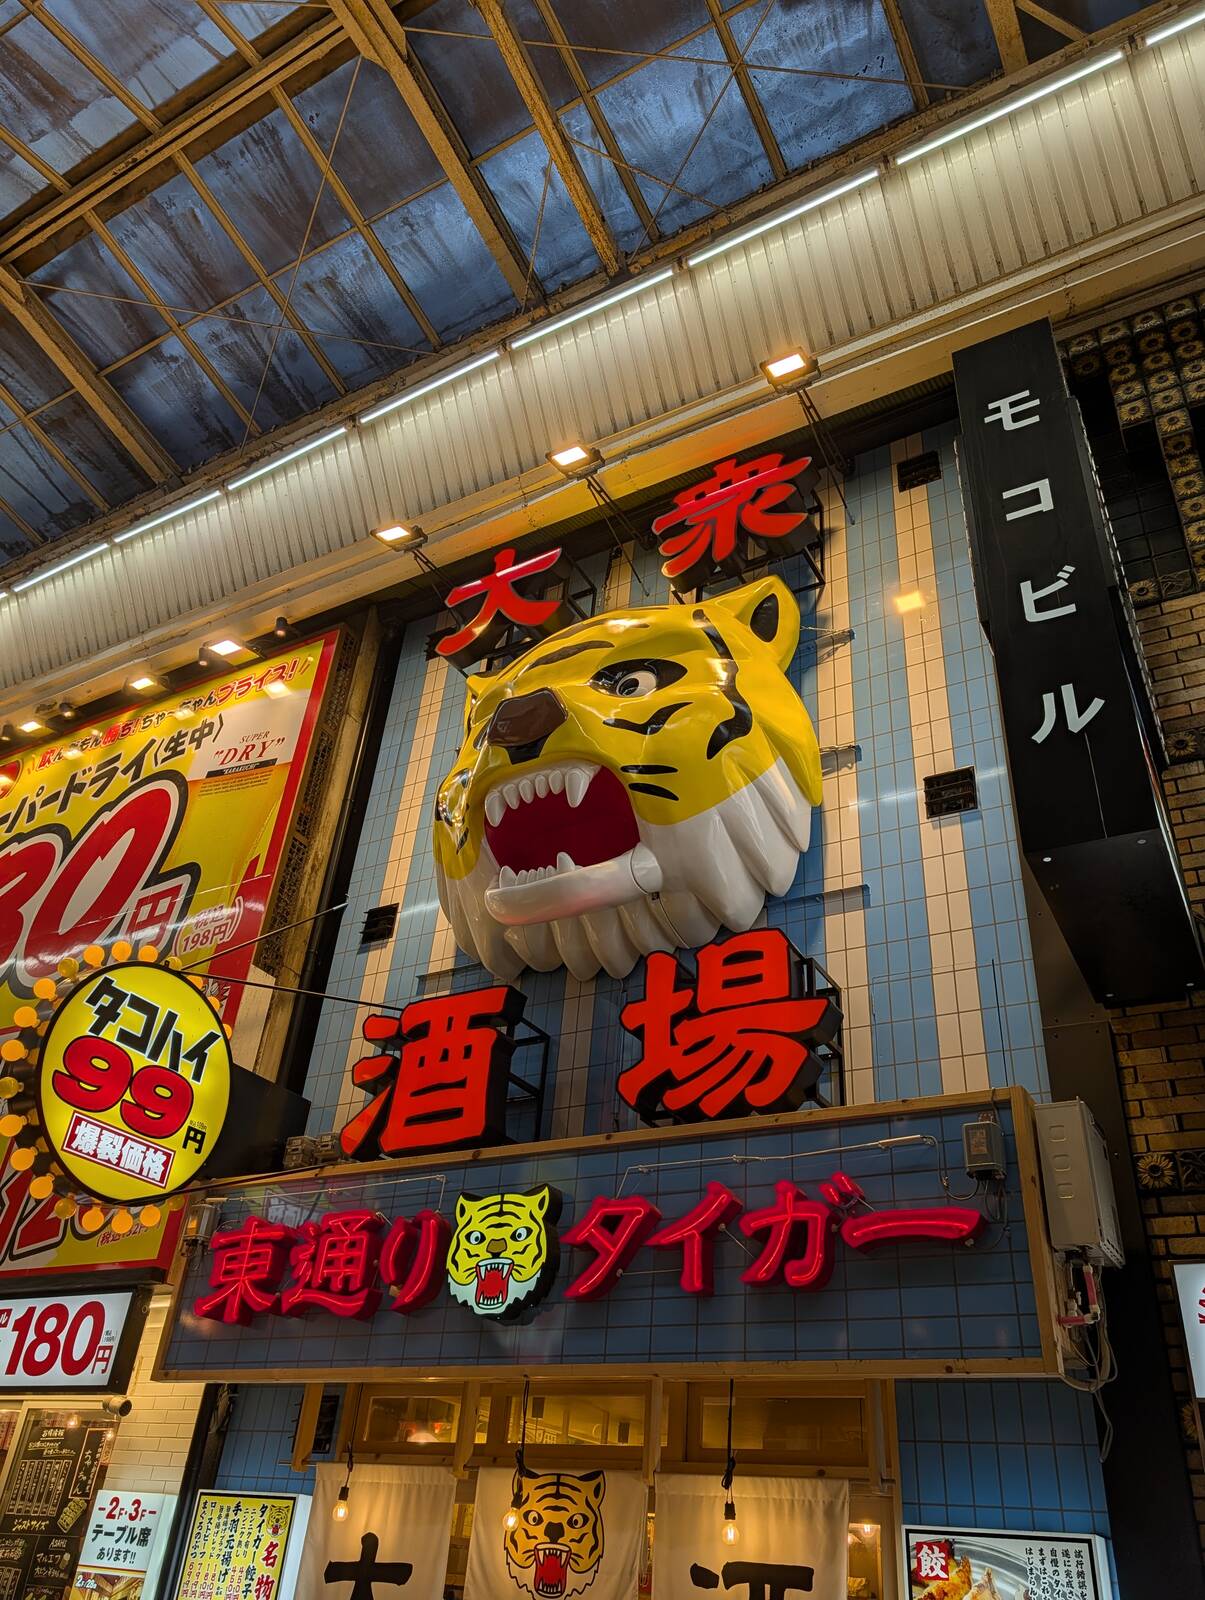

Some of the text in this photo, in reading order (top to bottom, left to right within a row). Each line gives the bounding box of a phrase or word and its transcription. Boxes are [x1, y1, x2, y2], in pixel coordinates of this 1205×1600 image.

[984, 390, 1105, 743] モコビル
[240, 731, 270, 744] SUPER
[86, 977, 220, 1083] タコハイ
[340, 928, 829, 1156] 酒場
[52, 1035, 194, 1139] 99
[71, 1121, 167, 1181] 爆裂価格
[182, 1126, 206, 1154] 円
[193, 1171, 987, 1327] 東通り タイガー
[91, 1523, 152, 1548] テーブル席
[242, 1503, 269, 1600] タイガー餃子
[255, 1541, 279, 1600] 名物
[917, 1544, 949, 1579] 餃
